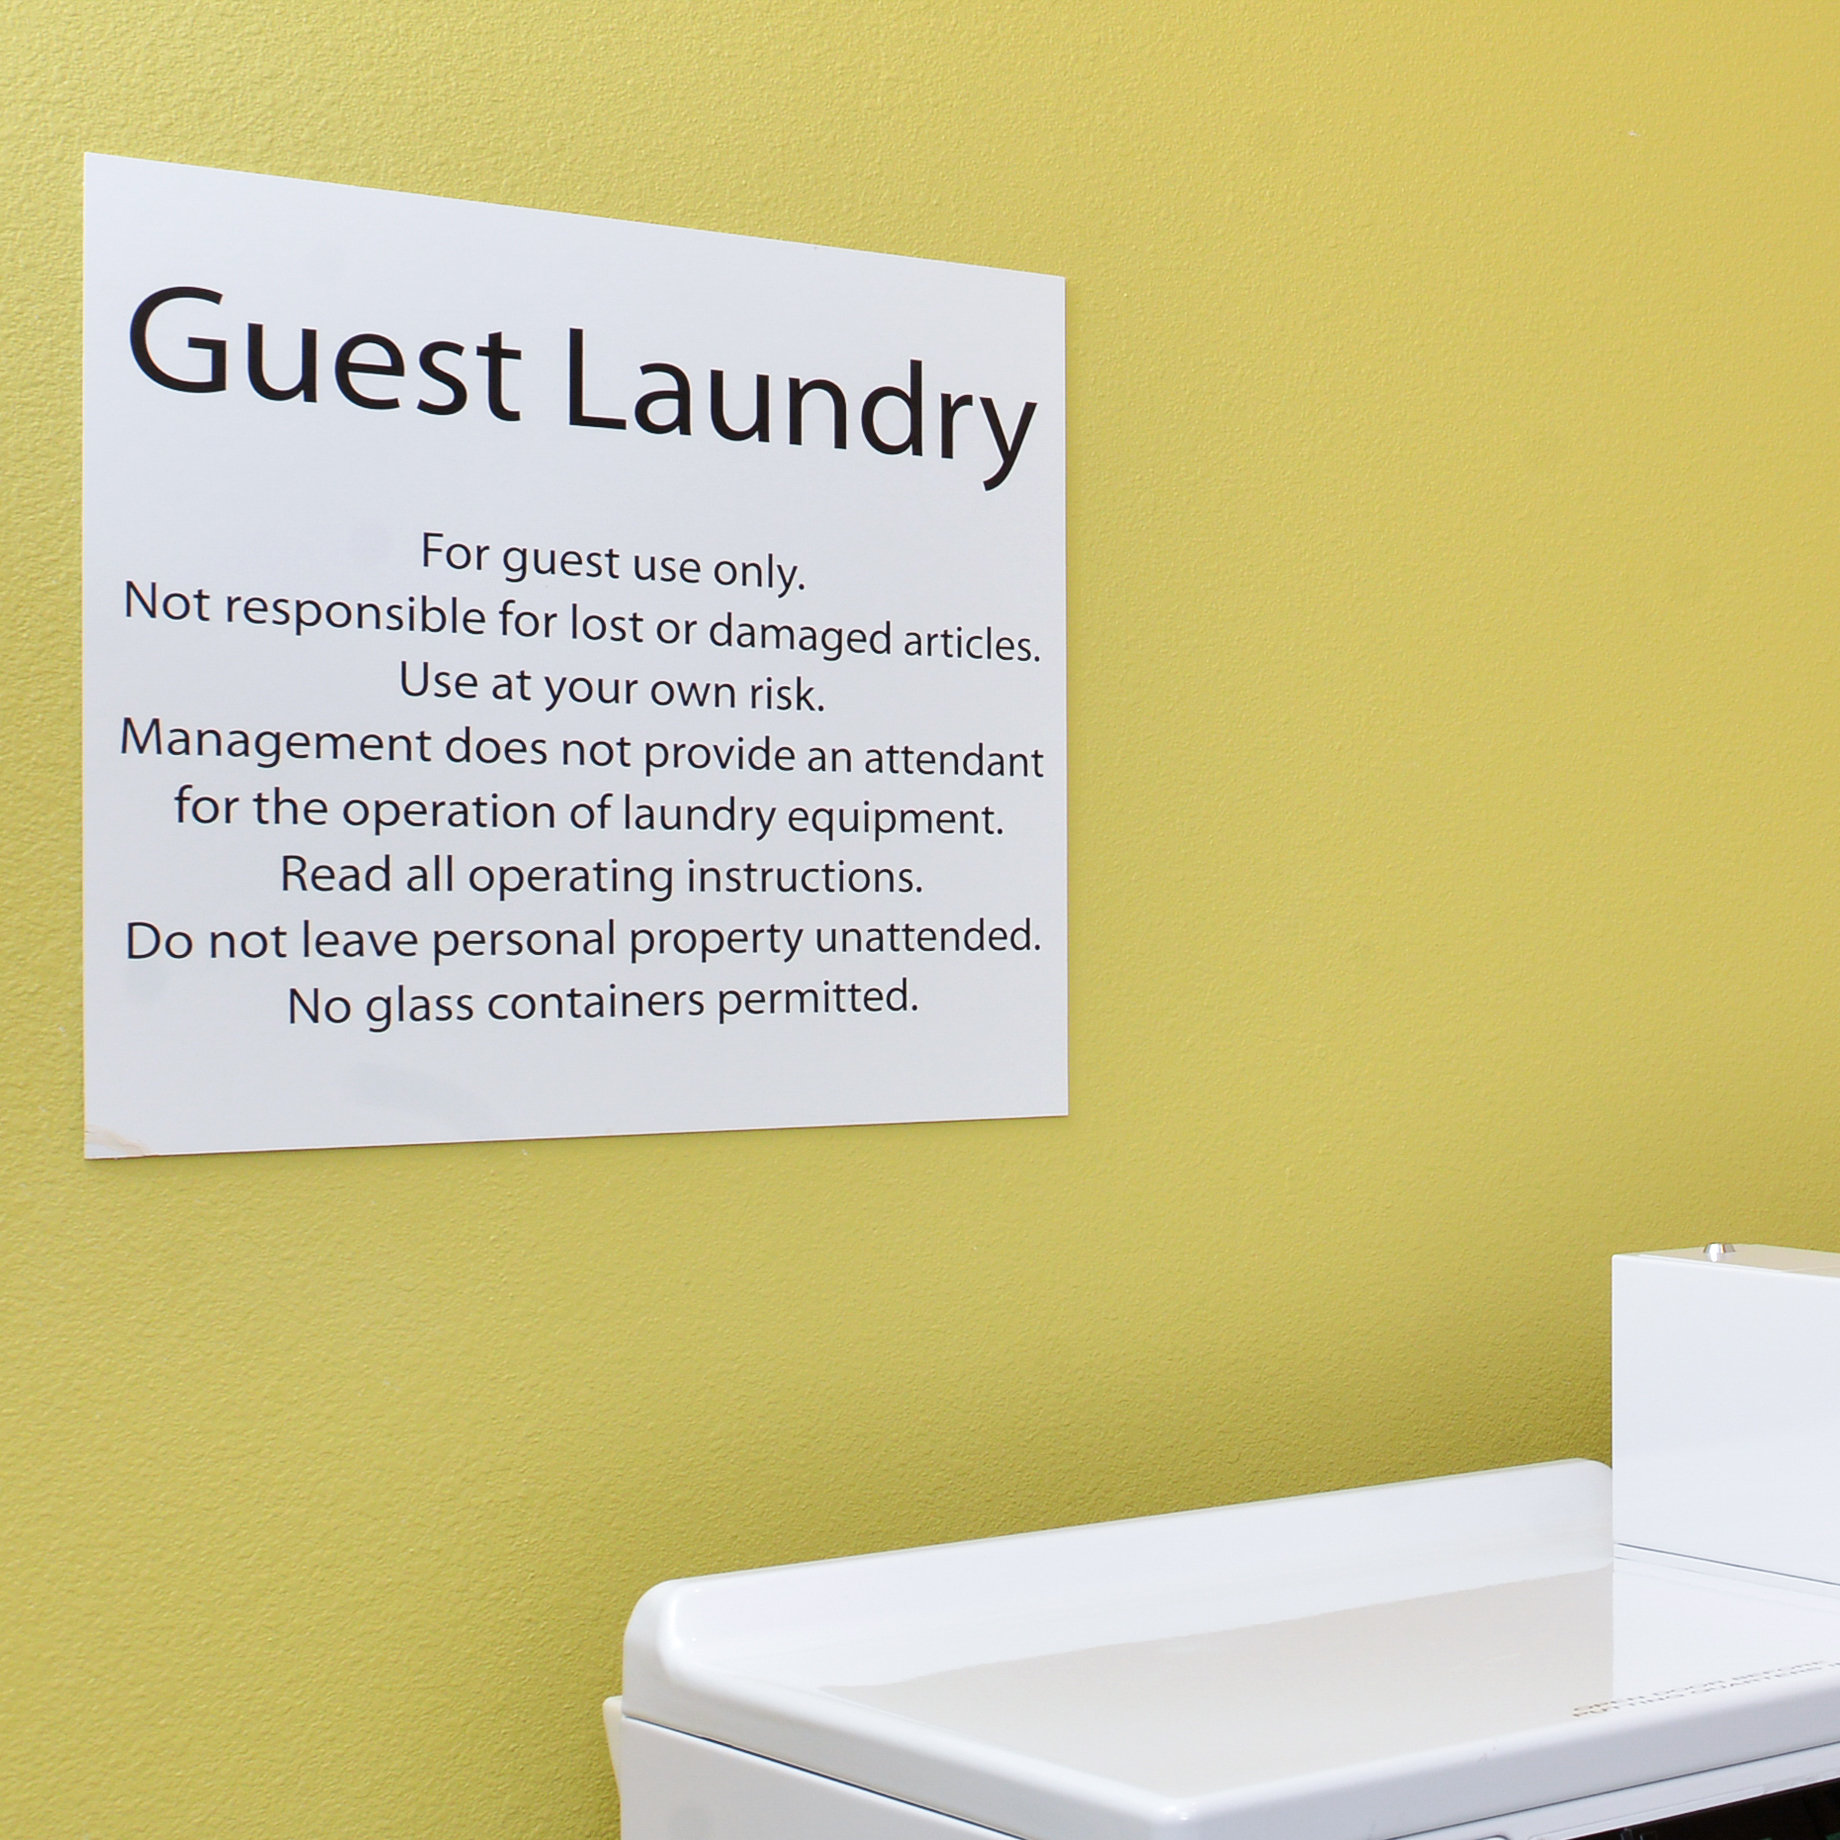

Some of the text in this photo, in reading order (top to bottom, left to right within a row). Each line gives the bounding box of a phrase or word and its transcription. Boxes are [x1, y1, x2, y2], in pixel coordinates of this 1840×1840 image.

[129, 286, 1038, 492] Guest Laundry
[423, 532, 805, 599] For guest use only.
[126, 580, 1040, 662] Not responsible for lost or damaged articles.
[401, 660, 824, 712] Use at your own risk.
[121, 717, 1044, 778] Management does not provide an attendant
[173, 784, 1003, 842] for the operation of laundry equipment.
[282, 854, 922, 902] Read all operating instructions.
[127, 917, 1041, 967] Do not leave personal property unattended.
[289, 977, 918, 1033] No glass containers permitted.
